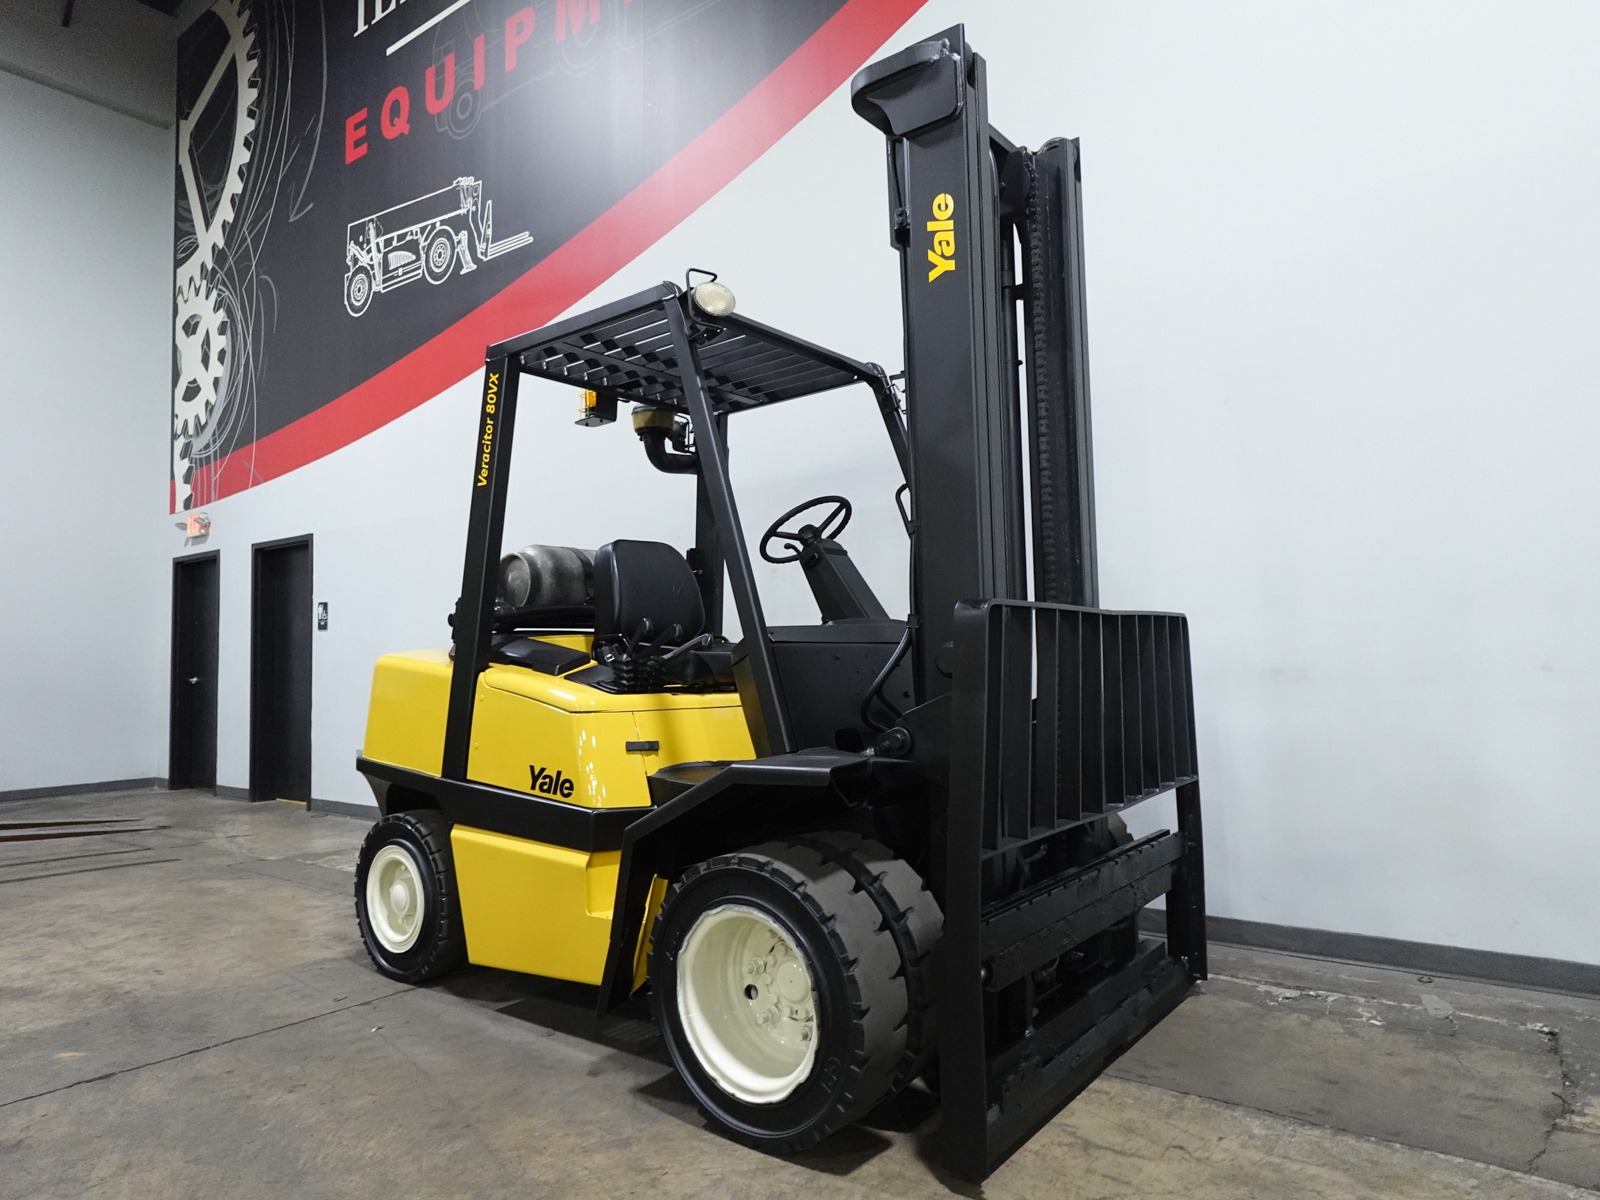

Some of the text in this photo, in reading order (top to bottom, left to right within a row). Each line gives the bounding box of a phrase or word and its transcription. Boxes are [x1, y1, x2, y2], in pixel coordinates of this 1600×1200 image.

[345, 0, 633, 165] EQUIPM
[927, 193, 956, 282] Yale
[477, 373, 499, 487] Veracitor 80VX
[529, 764, 575, 798] Yale
